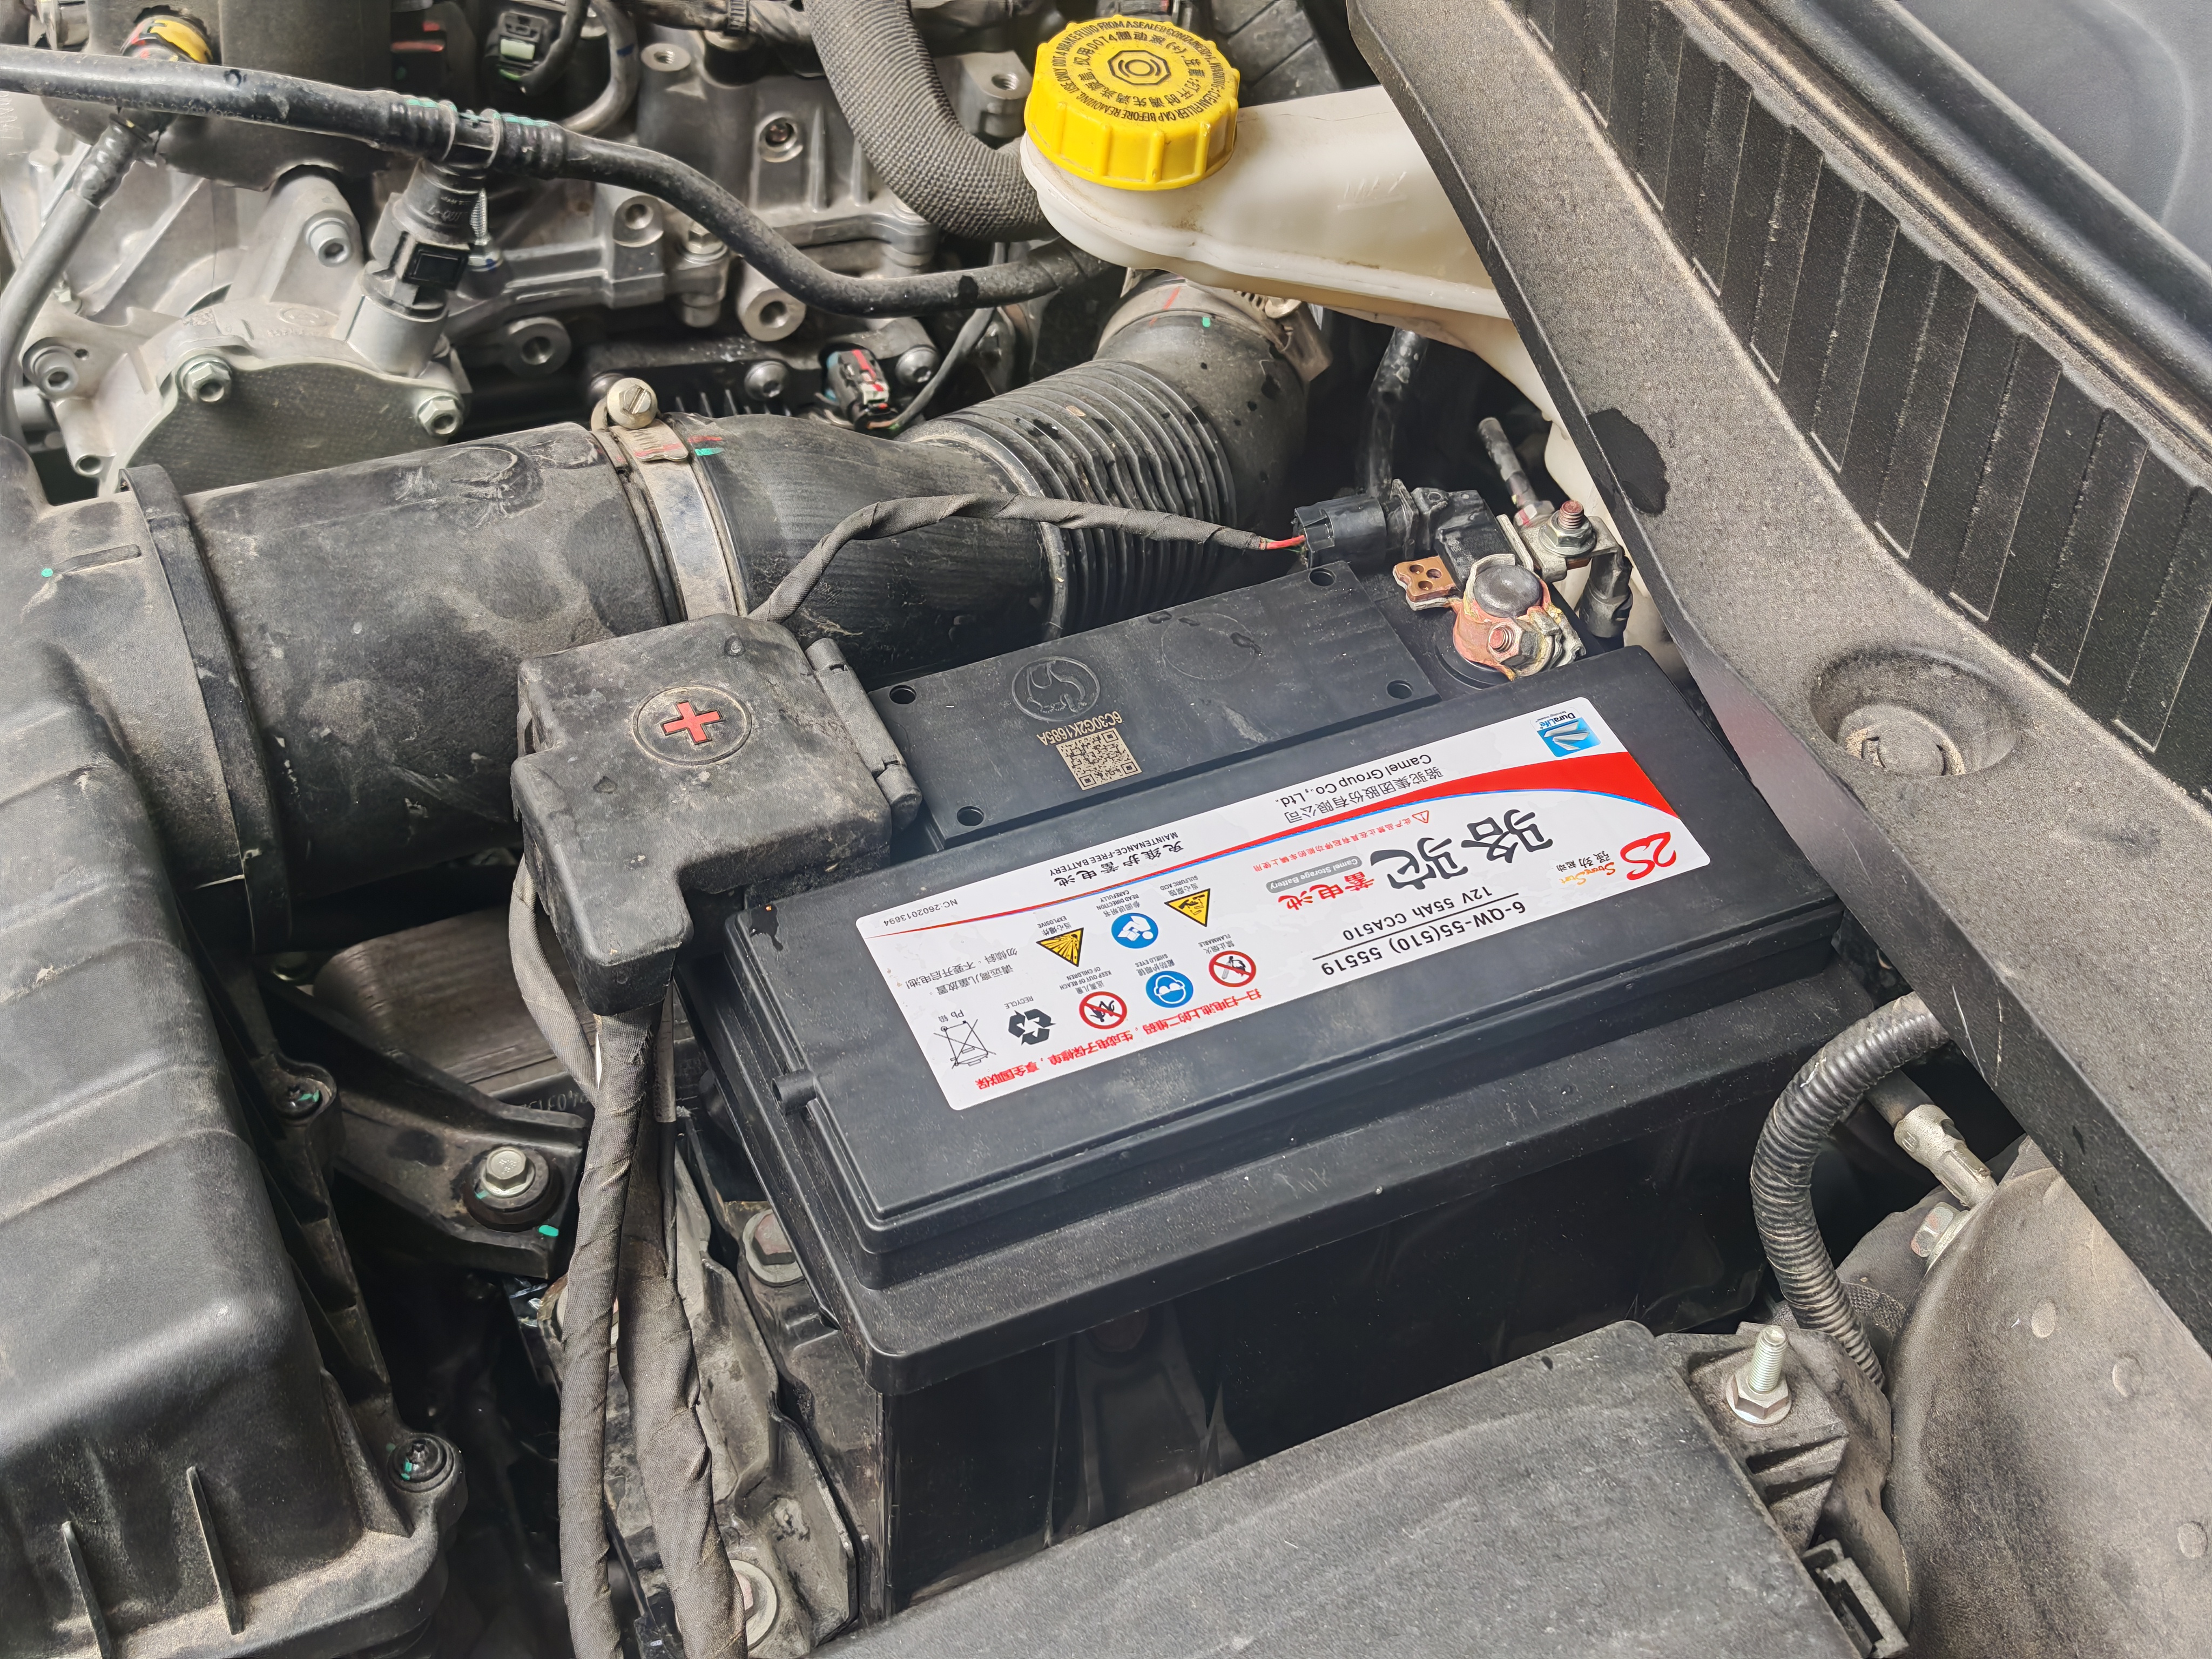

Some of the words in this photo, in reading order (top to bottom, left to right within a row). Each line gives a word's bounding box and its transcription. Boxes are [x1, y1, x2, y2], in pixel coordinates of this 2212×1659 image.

[1075, 24, 1099, 37] FLUID
[1097, 21, 1125, 31] FROM
[1057, 33, 1078, 51] BRAKE
[1054, 68, 1069, 82] ONLY
[1060, 83, 1080, 93] USE
[1076, 92, 1122, 117] REMOVING.
[1198, 91, 1221, 109] CLEAN
[1120, 110, 1157, 122] BEFORE
[1158, 111, 1177, 122] CAP
[1175, 104, 1205, 118] FILLER
[1037, 711, 1123, 746] 6C30G2K1685A
[1384, 754, 1432, 775] Camel
[1338, 769, 1384, 787] Group
[1284, 766, 1444, 824] 骆驼集团股份有限公司
[1305, 783, 1337, 794] Co.,
[1275, 793, 1306, 807] Ltd.
[1089, 832, 1178, 864] MAINTENANCE-FREE
[1370, 809, 1553, 890] 骆驼
[1050, 859, 1089, 876] BATTERY
[1054, 840, 1184, 887] 免维护蓄电池
[1332, 859, 1358, 871] Camel
[1300, 866, 1332, 880] Storage
[1172, 875, 1198, 887] SULFURIC
[1266, 876, 1299, 889] Battery
[1100, 889, 1130, 903] CAREFULLY
[1168, 883, 1199, 897] 当心腐蚀
[1278, 871, 1375, 911] 蓄电池
[1461, 886, 1493, 904] 12V
[1096, 898, 1125, 911] DIRECTION
[1124, 893, 1139, 902] READ
[884, 899, 958, 926] NC:2602013694
[1103, 900, 1140, 918] 参阅说明书
[1412, 898, 1455, 918] 55Ah
[1037, 915, 1067, 929] EXPLOSIVE
[1041, 922, 1072, 936] 当心爆炸
[1343, 913, 1407, 941] CCA510
[1389, 901, 1526, 954] 6-QW-55(510)
[1198, 933, 1231, 948] FLAMMABLE
[1135, 959, 1150, 968] EYES
[1149, 953, 1169, 963] SHIELD
[1321, 947, 1382, 975] 55519
[1066, 969, 1094, 981] CHILDREN
[1085, 974, 1098, 982] OUT
[1098, 970, 1112, 979] KEEP
[1059, 980, 1078, 990] REACH
[1004, 995, 1034, 1009] RECYCLE
[938, 1014, 949, 1023] 铅
[950, 1009, 965, 1019] Pb
